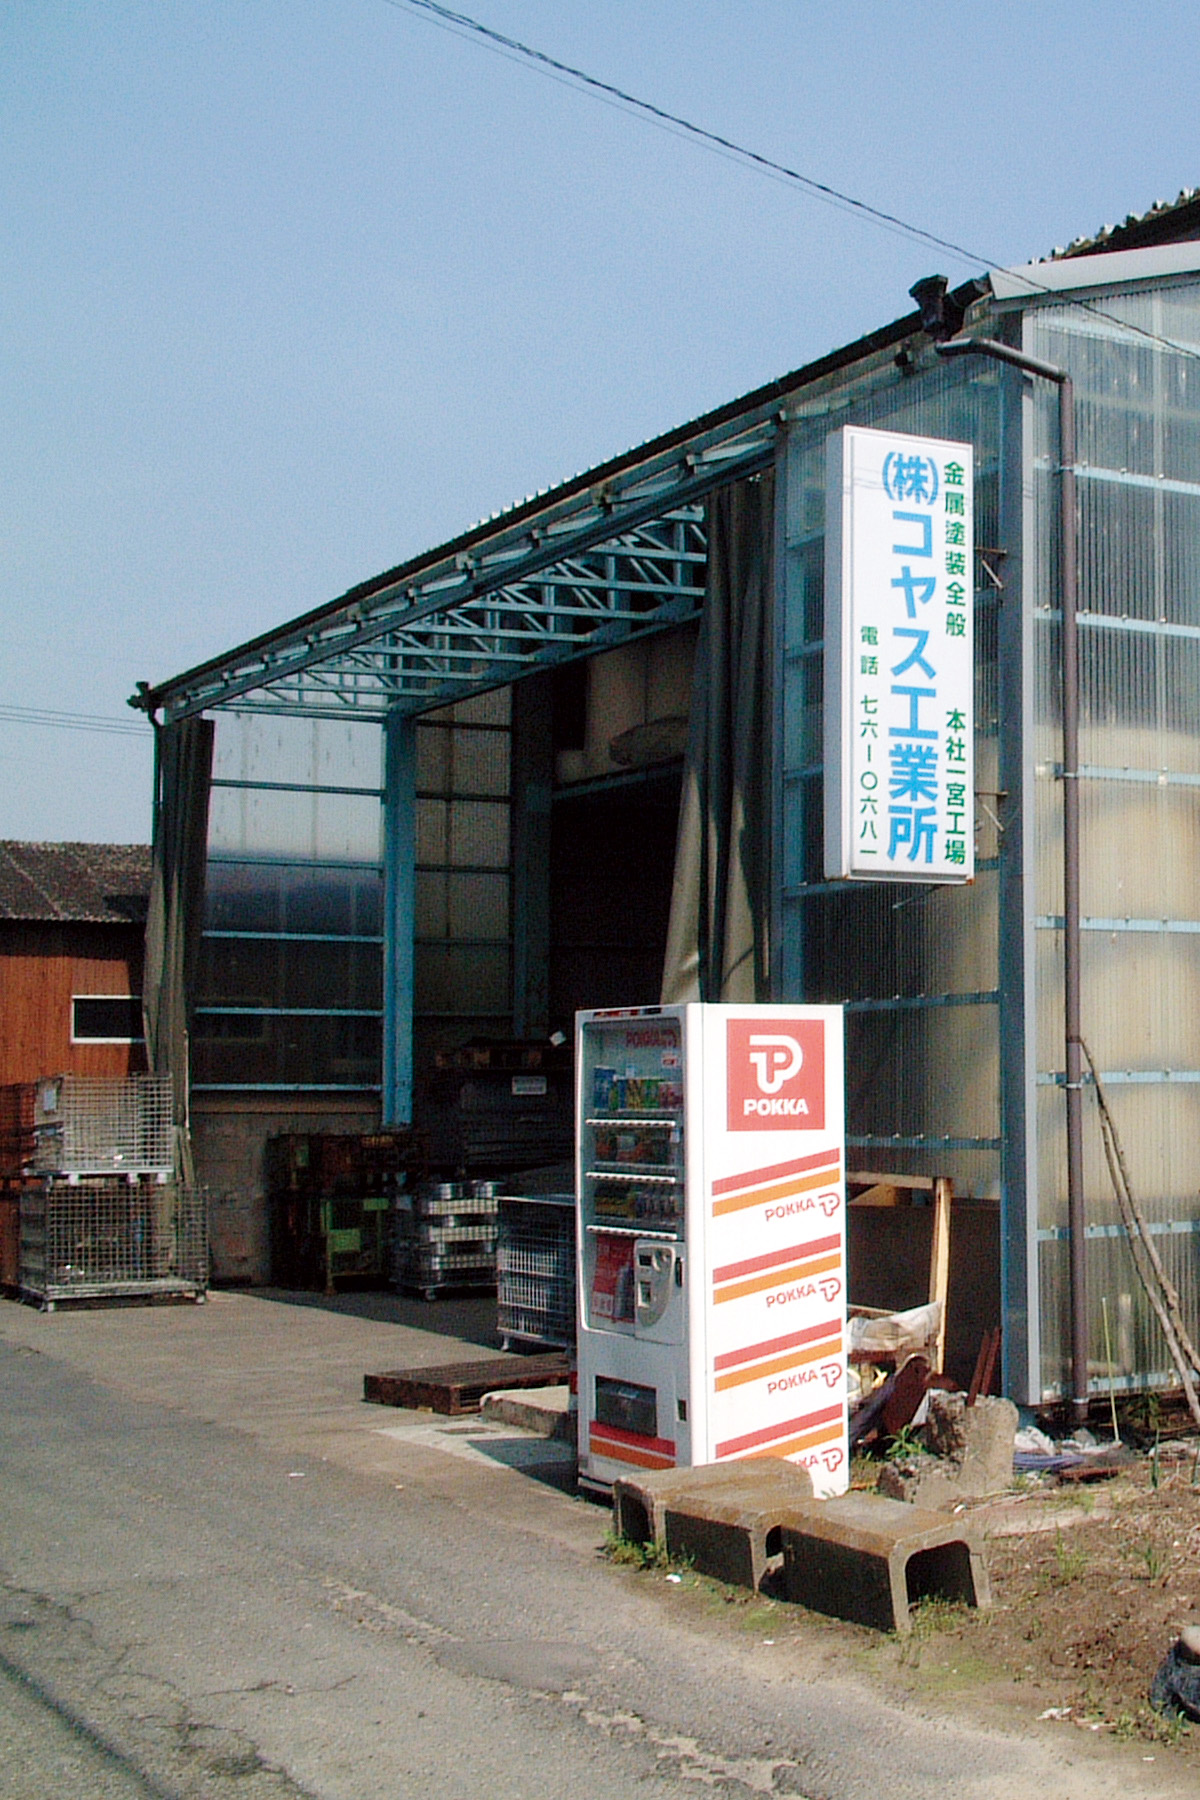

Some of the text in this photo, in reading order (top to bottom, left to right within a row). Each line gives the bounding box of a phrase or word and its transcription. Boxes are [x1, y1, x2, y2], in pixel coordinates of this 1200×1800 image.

[860, 625, 879, 677] 電話
[944, 460, 967, 865] 金属塗装全般 本社一宮工場
[743, 1098, 809, 1116] POKKA
[765, 1198, 816, 1222] POKKA
[766, 1284, 817, 1308] POKKA
[767, 1369, 819, 1395] POKKA
